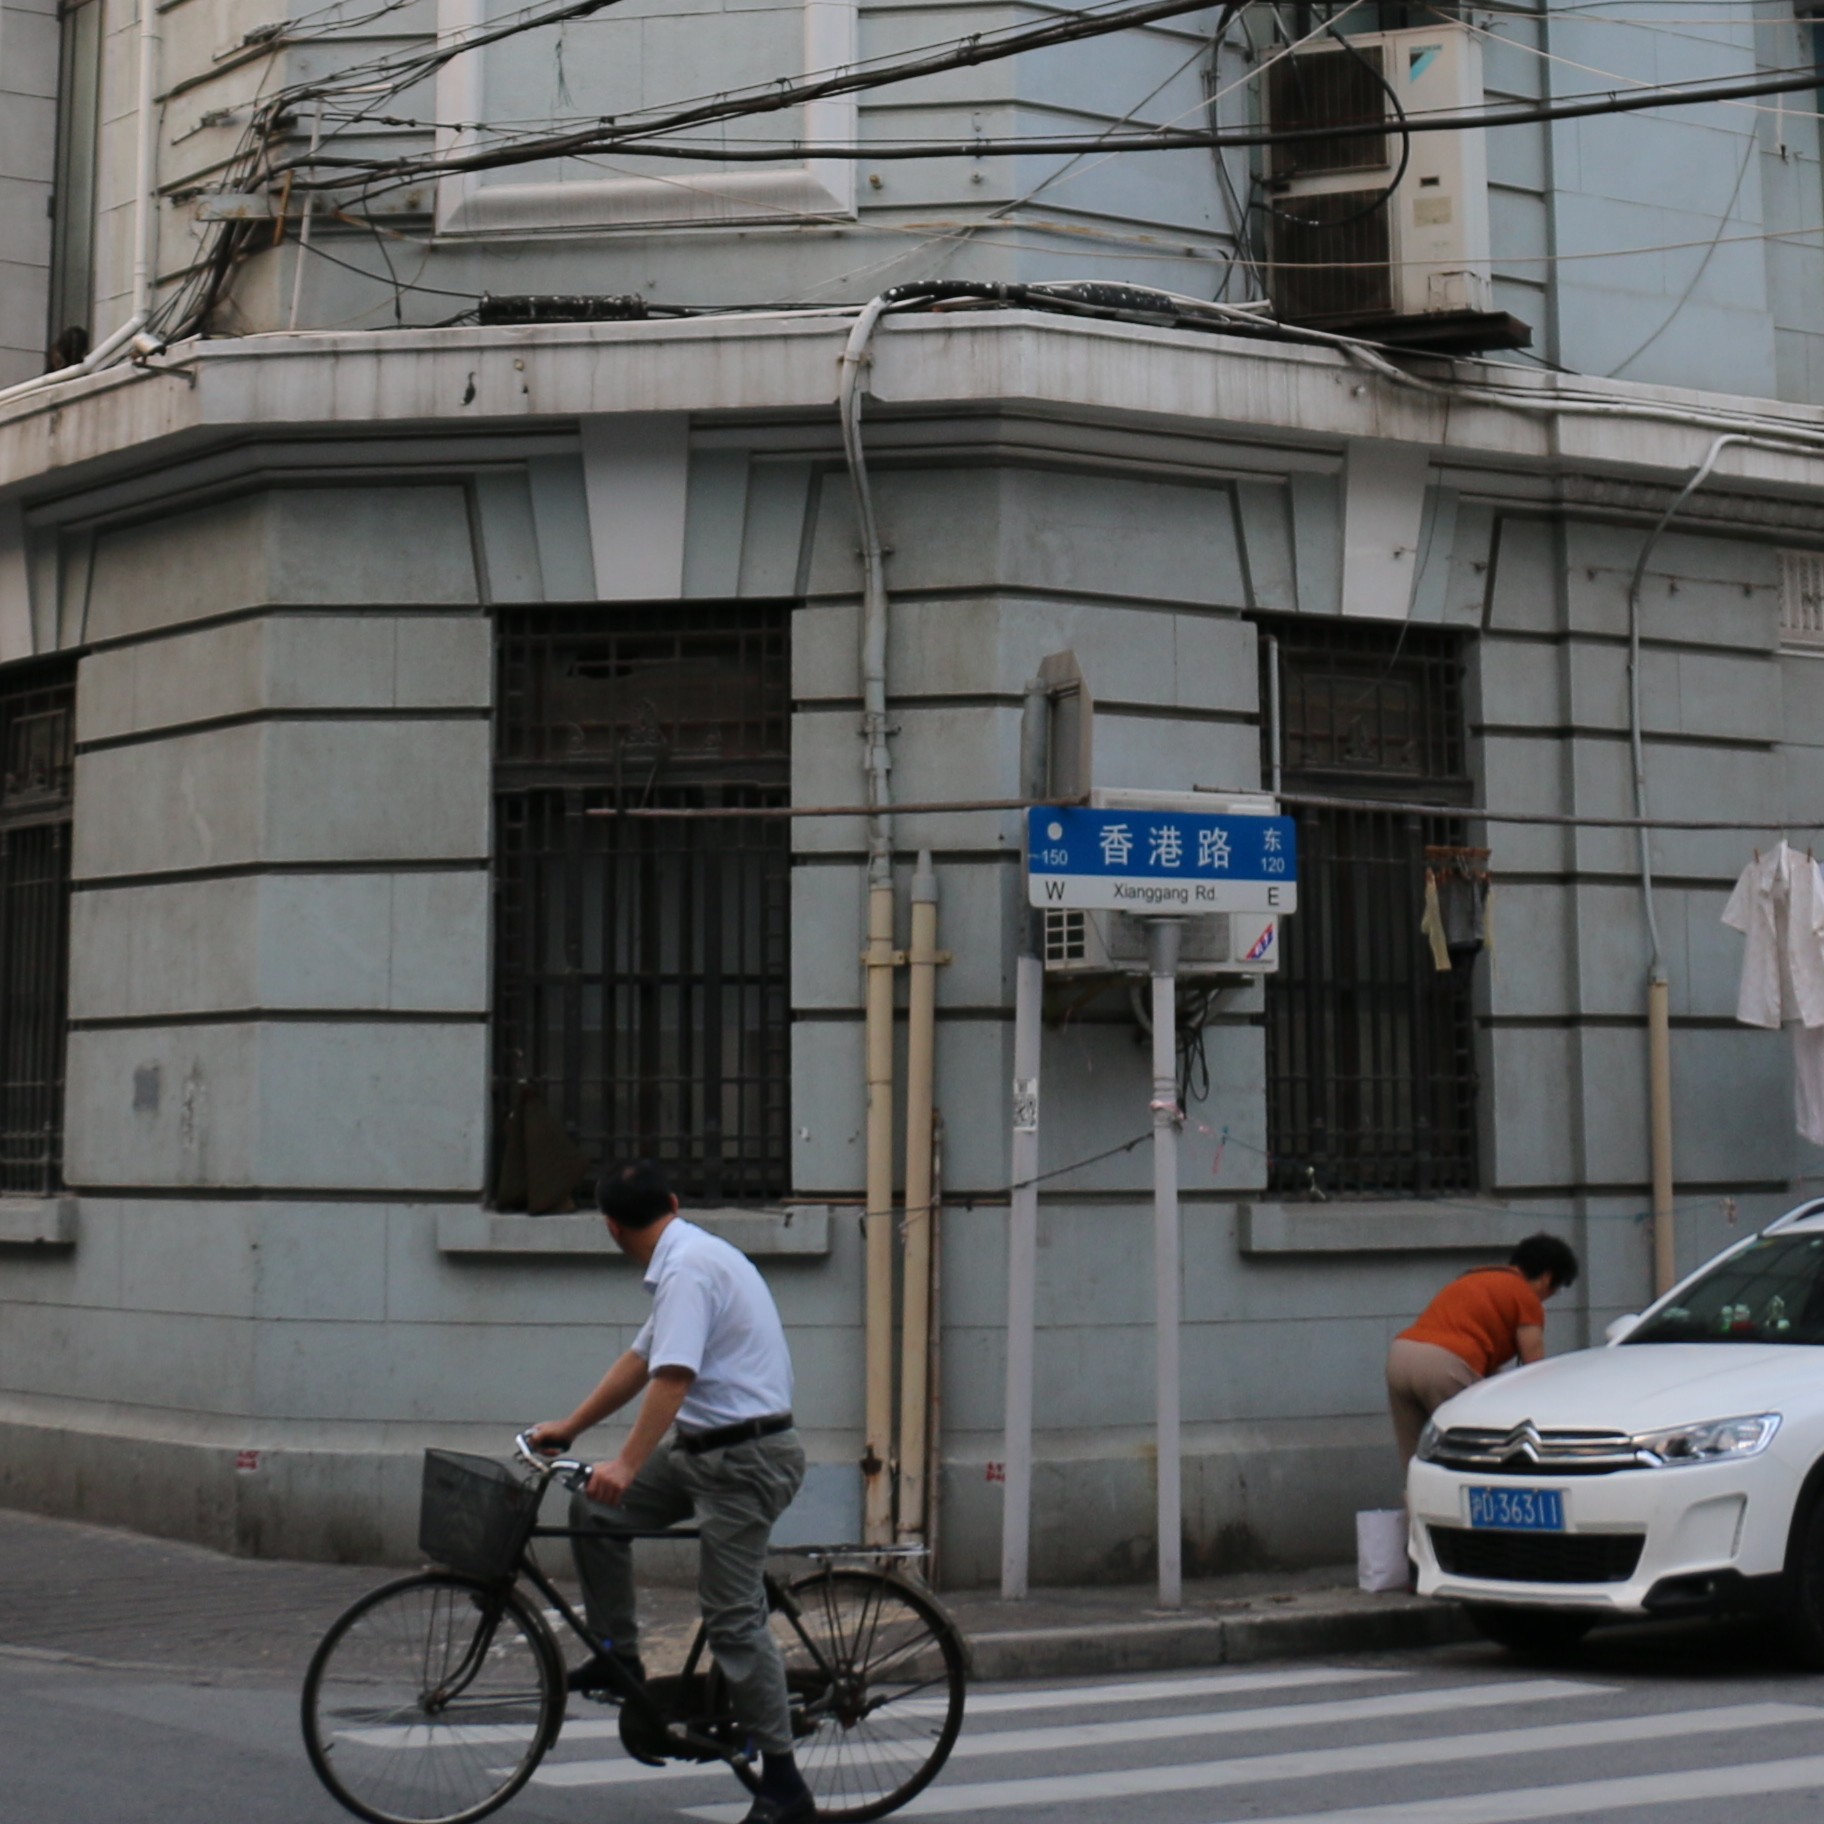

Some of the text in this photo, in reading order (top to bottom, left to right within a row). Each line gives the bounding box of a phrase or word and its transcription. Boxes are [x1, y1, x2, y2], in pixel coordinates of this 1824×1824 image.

[1099, 823, 1232, 869] 香港路
[1263, 827, 1282, 853] 东
[1041, 850, 1069, 866] 150
[1261, 857, 1285, 873] 120
[1045, 880, 1066, 901] W
[1113, 883, 1189, 904] Xianggang
[1267, 886, 1280, 907] E
